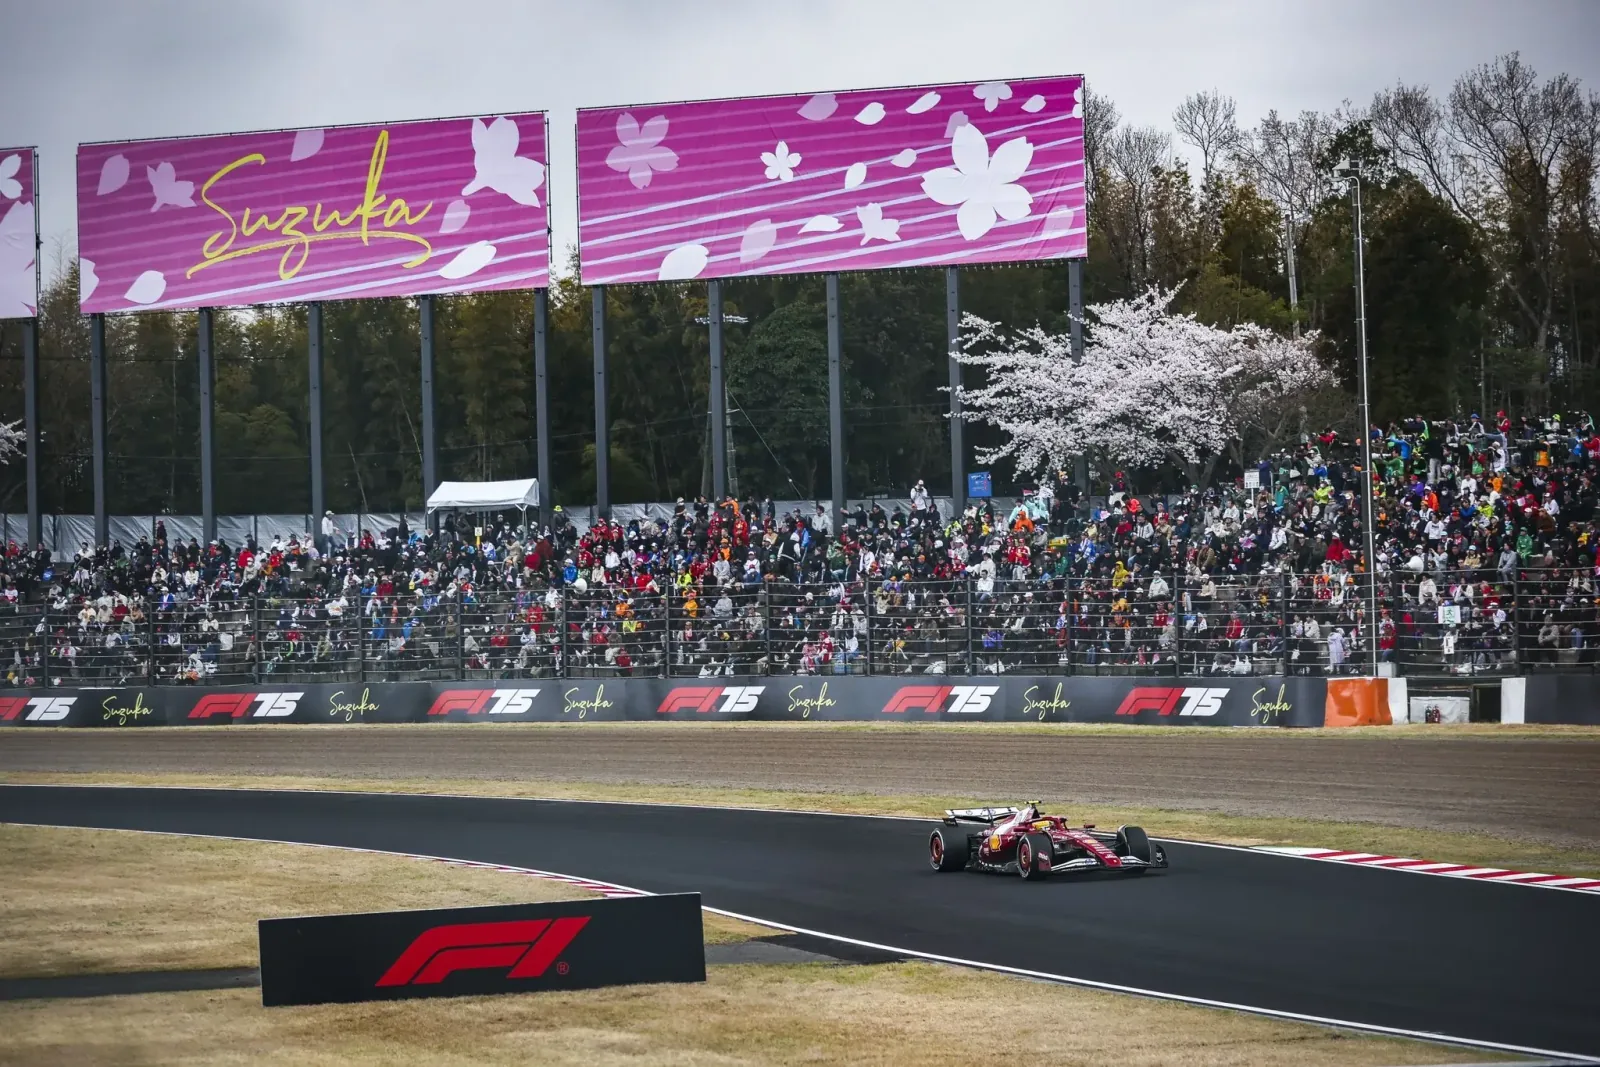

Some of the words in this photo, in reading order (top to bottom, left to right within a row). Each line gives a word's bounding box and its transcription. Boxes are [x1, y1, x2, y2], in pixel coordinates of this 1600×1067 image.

[187, 130, 433, 280] Suzuka
[102, 692, 154, 726] Suzuka
[329, 687, 381, 722] Suzuka
[564, 684, 614, 719] Suzuka
[787, 682, 837, 718] Suzuka
[1023, 682, 1072, 721] Suzuka
[1250, 683, 1292, 724] Suzuka
[375, 916, 592, 987] F1
